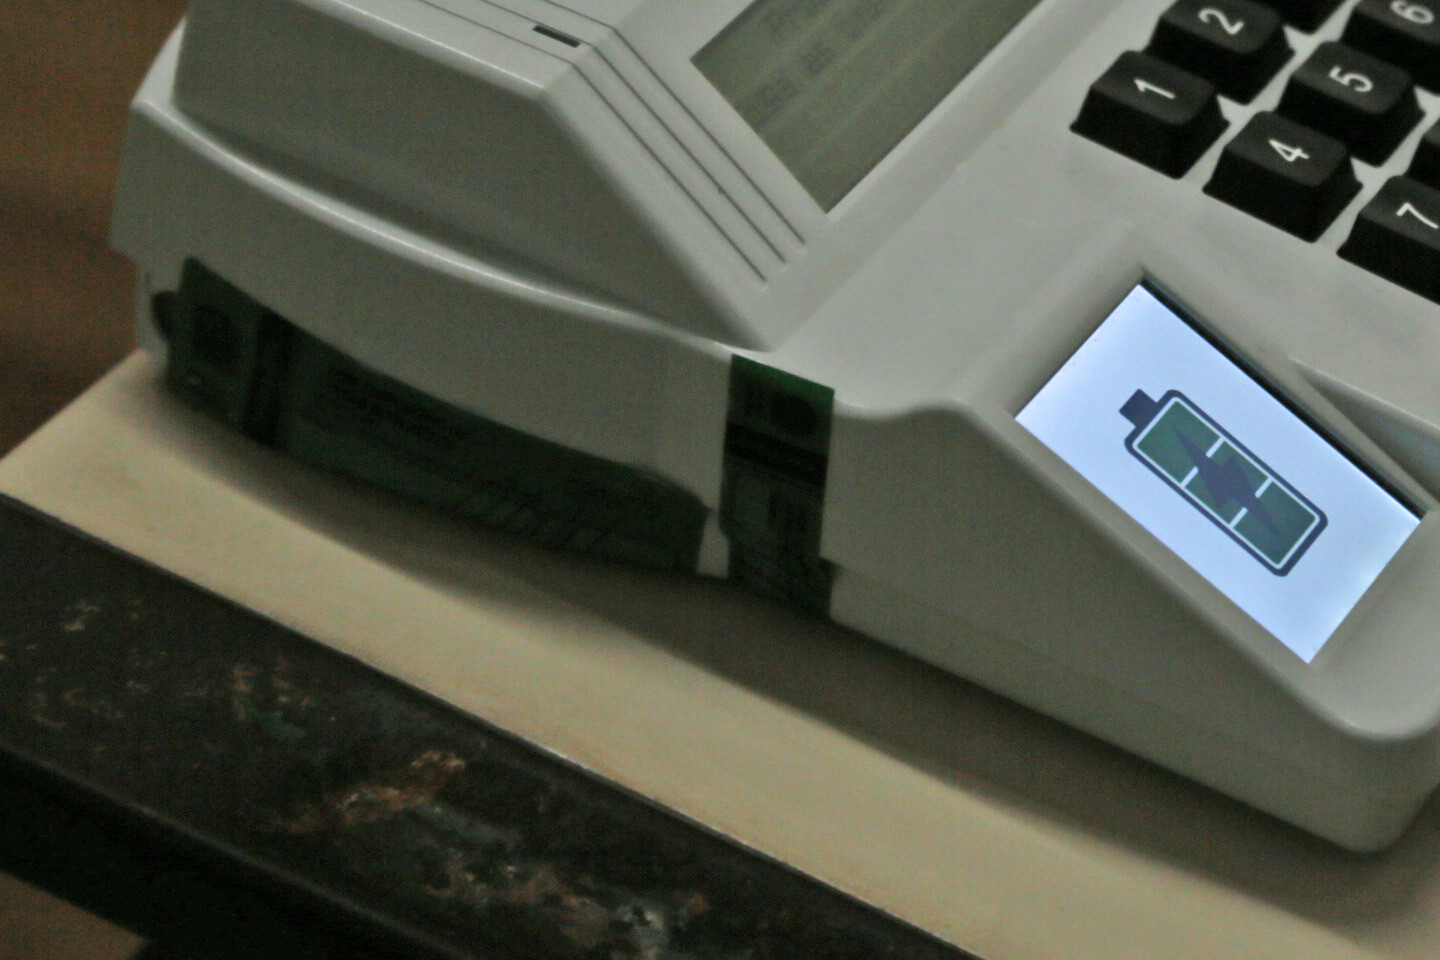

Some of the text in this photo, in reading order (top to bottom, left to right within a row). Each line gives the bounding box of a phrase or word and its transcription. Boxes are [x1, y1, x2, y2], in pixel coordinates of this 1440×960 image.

[1198, 7, 1244, 35] 2
[1390, 0, 1433, 24] 6
[1134, 78, 1174, 100] 1
[1328, 66, 1372, 92] 5
[1268, 138, 1309, 162] 4
[1395, 201, 1439, 229] 7
